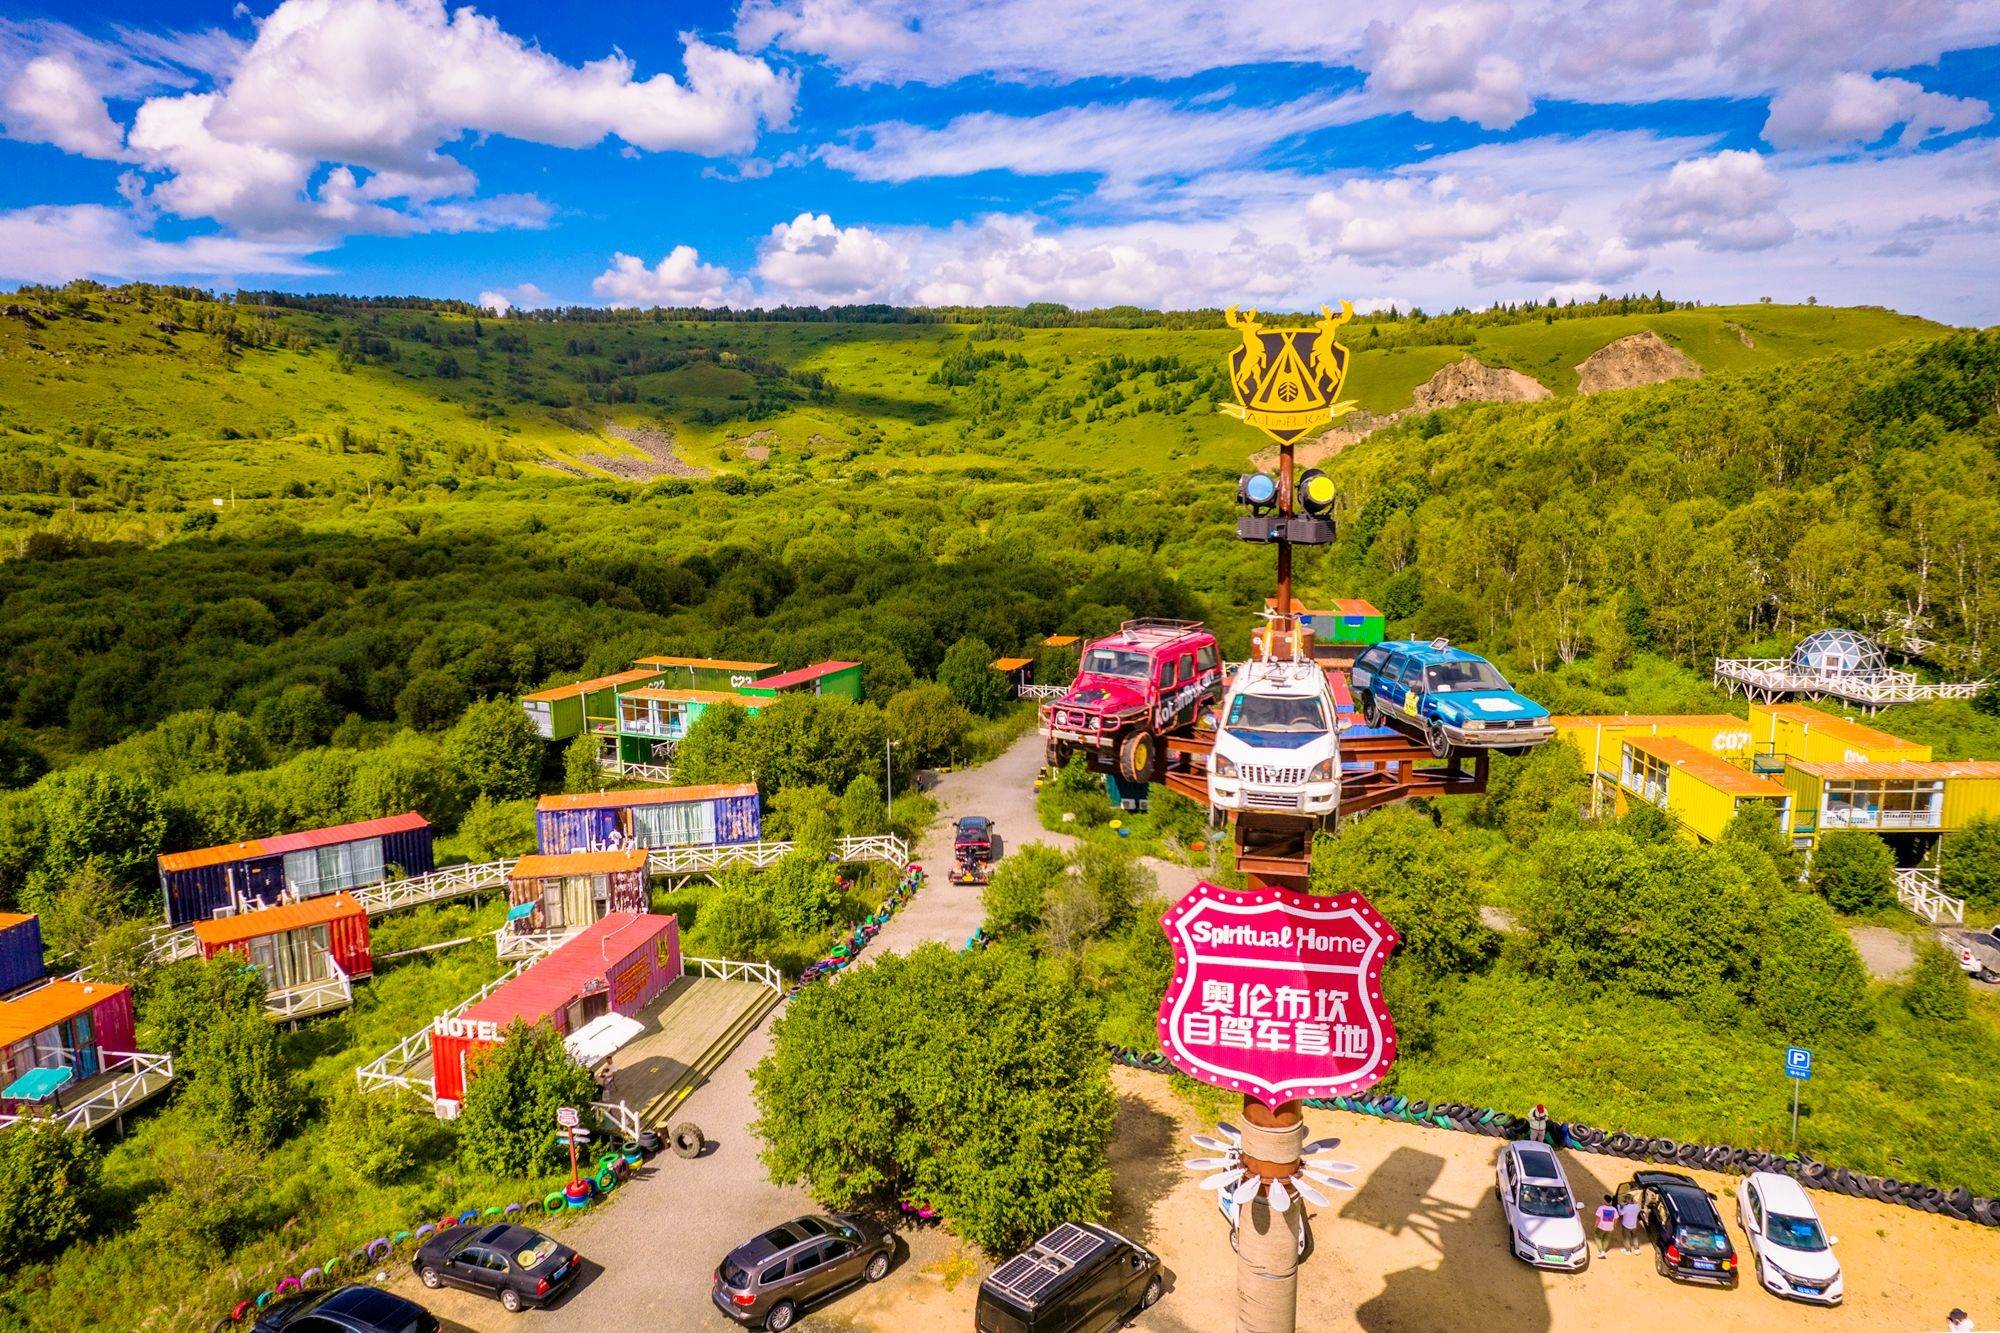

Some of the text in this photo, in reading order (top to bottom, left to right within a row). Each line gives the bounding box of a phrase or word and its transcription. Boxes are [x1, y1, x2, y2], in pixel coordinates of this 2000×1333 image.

[1191, 920, 1366, 956] Spiritual Home
[1201, 979, 1349, 1023] 奥伦布坎
[434, 1015, 506, 1042] HOTEL
[1183, 1011, 1368, 1059] 自驾车营地
[1793, 1052, 1806, 1065] P
